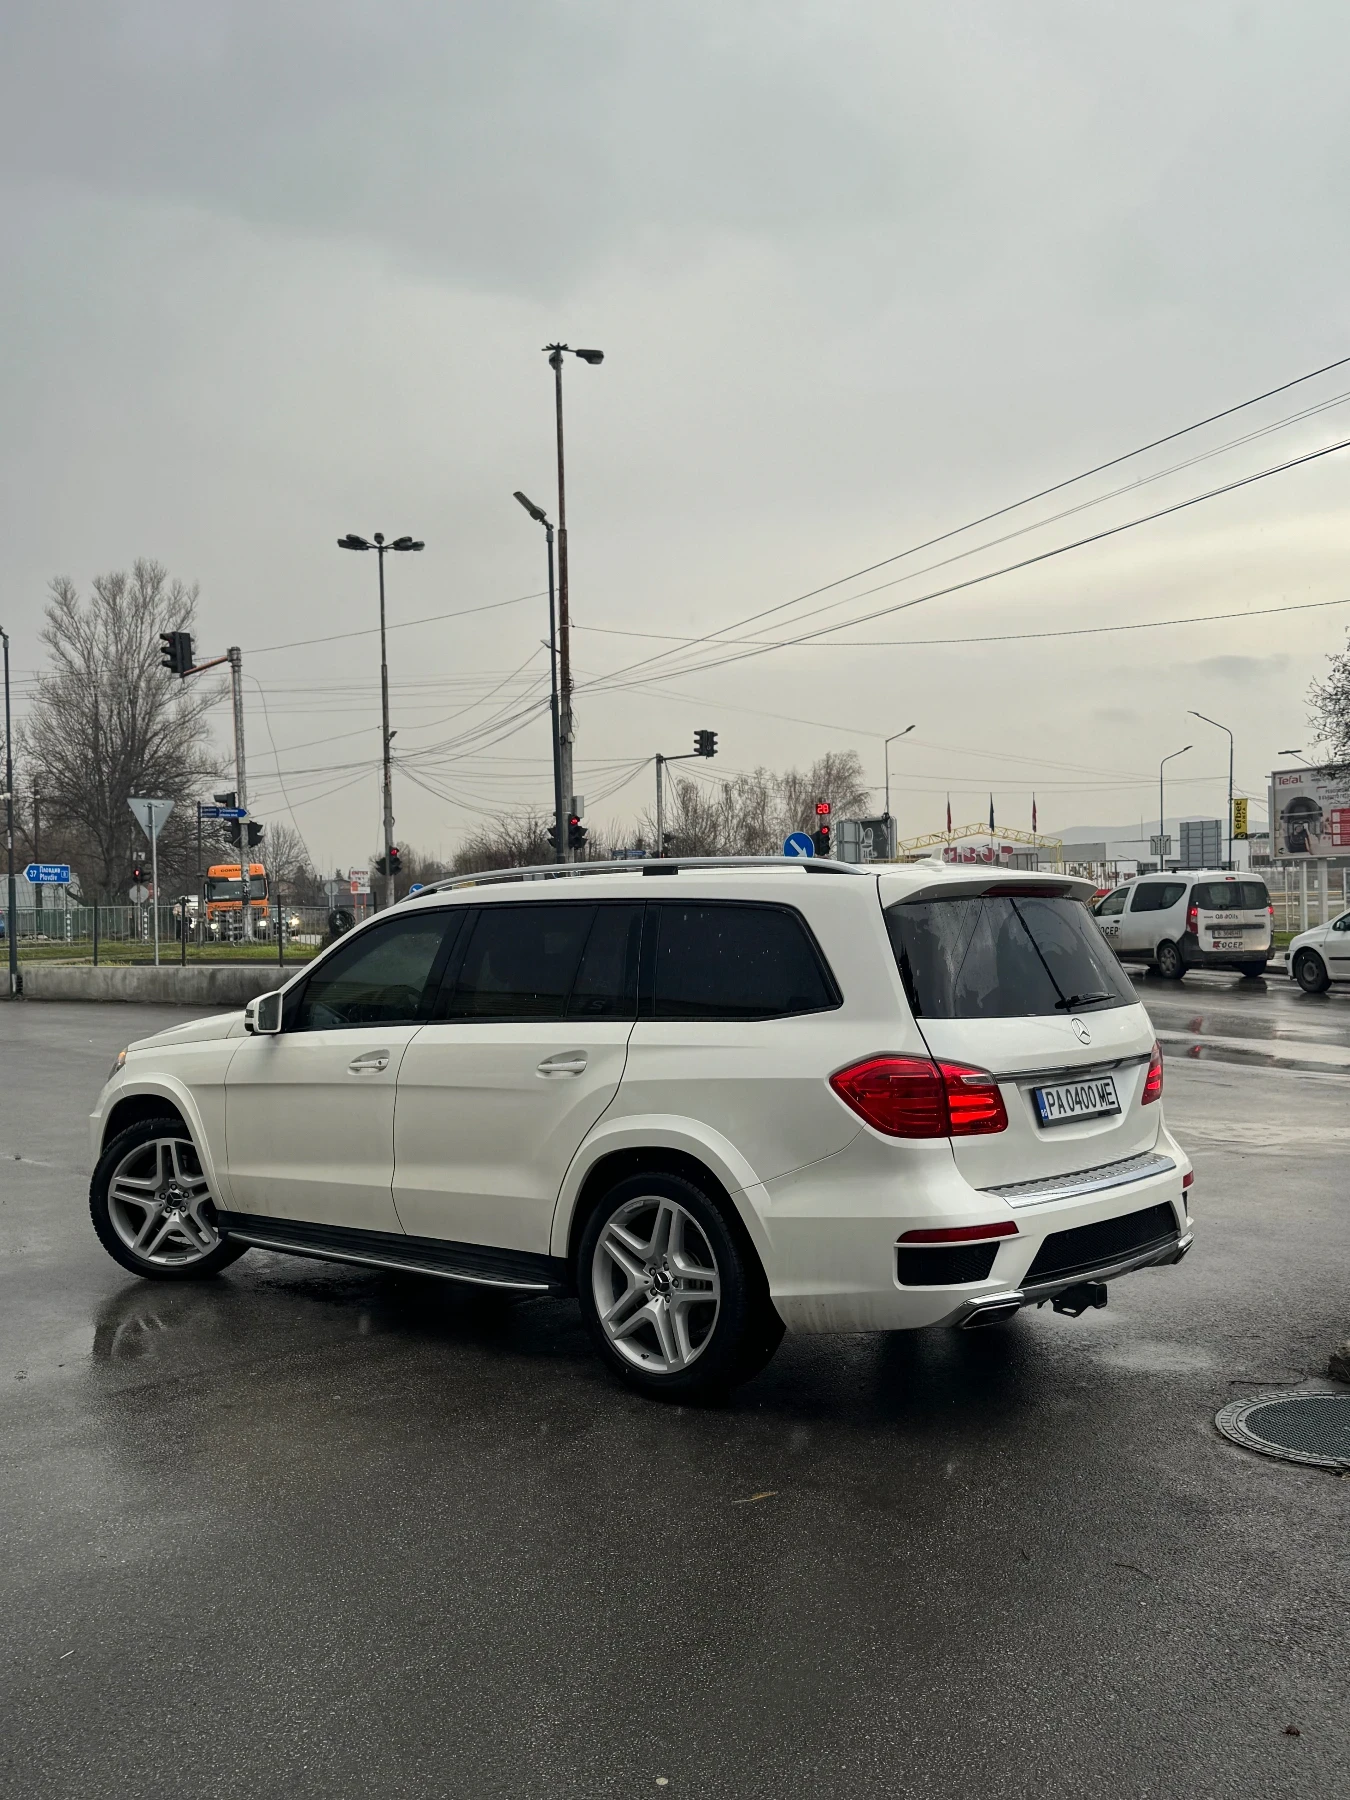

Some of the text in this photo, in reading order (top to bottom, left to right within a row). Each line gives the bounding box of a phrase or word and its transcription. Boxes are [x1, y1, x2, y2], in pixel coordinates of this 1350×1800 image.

[1277, 774, 1304, 786] Tefal
[817, 804, 829, 814] 28
[29, 870, 37, 878] 37
[39, 865, 61, 874] Пловдив
[39, 873, 58, 881] Plovdiv
